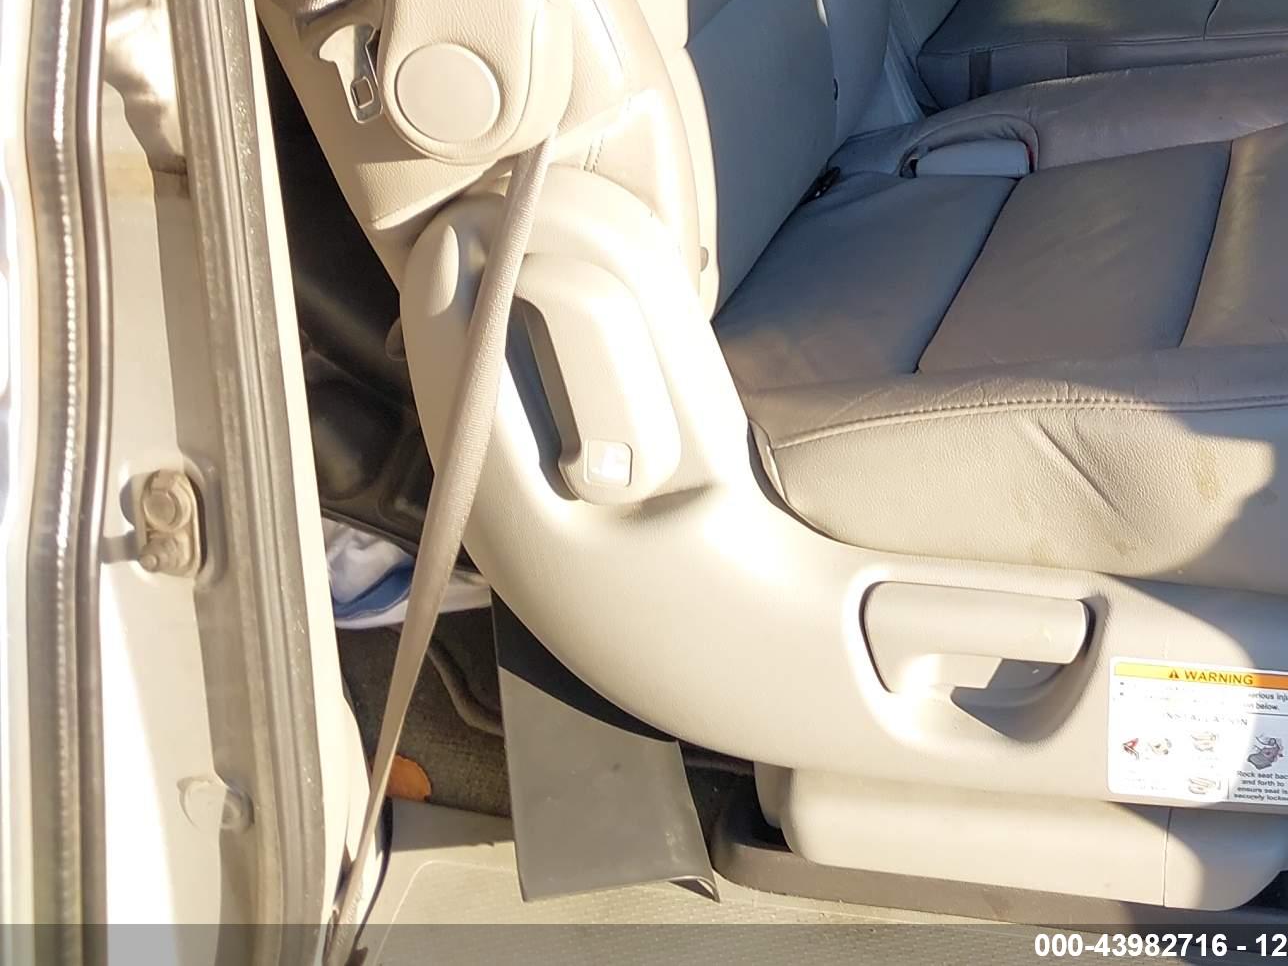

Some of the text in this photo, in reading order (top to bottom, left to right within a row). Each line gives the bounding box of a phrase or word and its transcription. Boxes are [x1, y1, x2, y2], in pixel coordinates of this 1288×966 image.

[1184, 670, 1254, 685] WARNING
[1248, 691, 1275, 700] erious
[1255, 702, 1280, 711] below.
[1233, 793, 1265, 801] securely
